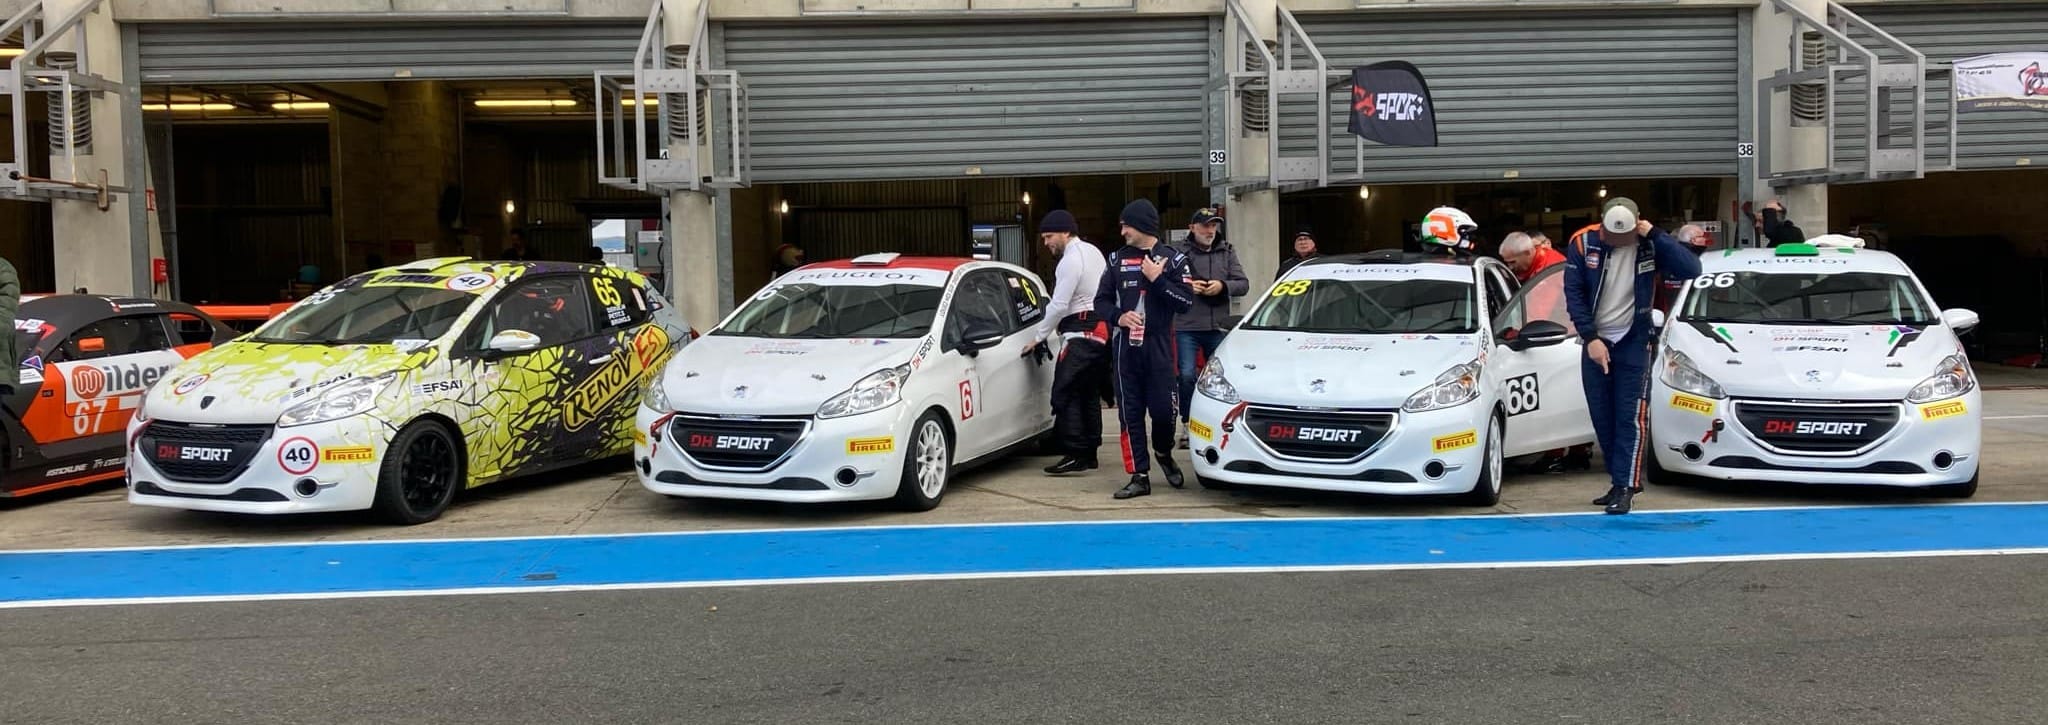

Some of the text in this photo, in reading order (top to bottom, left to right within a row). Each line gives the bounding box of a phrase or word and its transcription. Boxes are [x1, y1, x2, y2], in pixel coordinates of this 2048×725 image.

[1210, 151, 1225, 164] 39
[1739, 144, 1753, 156] 38
[458, 276, 486, 286] 40
[799, 271, 921, 281] PEUGEOT
[1693, 272, 1736, 289] 66
[592, 276, 622, 307] 65
[1021, 278, 1037, 306] 6
[1271, 280, 1312, 297] 68
[912, 334, 936, 370] DH SPORT
[72, 362, 169, 400] Wilder
[961, 382, 973, 419] 6
[1507, 375, 1538, 414] 68
[1671, 396, 1713, 412] PIRELLI
[1924, 402, 1964, 418] PIRELLI
[74, 400, 108, 436] 67
[1269, 426, 1361, 442] DH SPORT
[1764, 421, 1868, 435] DH SPORT
[691, 434, 774, 450] DH SPORT
[849, 439, 892, 452] PIRELLI
[1436, 432, 1474, 450] PIRELLI
[158, 445, 232, 461] DH SPORT
[285, 447, 311, 462] 40
[325, 448, 372, 461] PIRELLI
